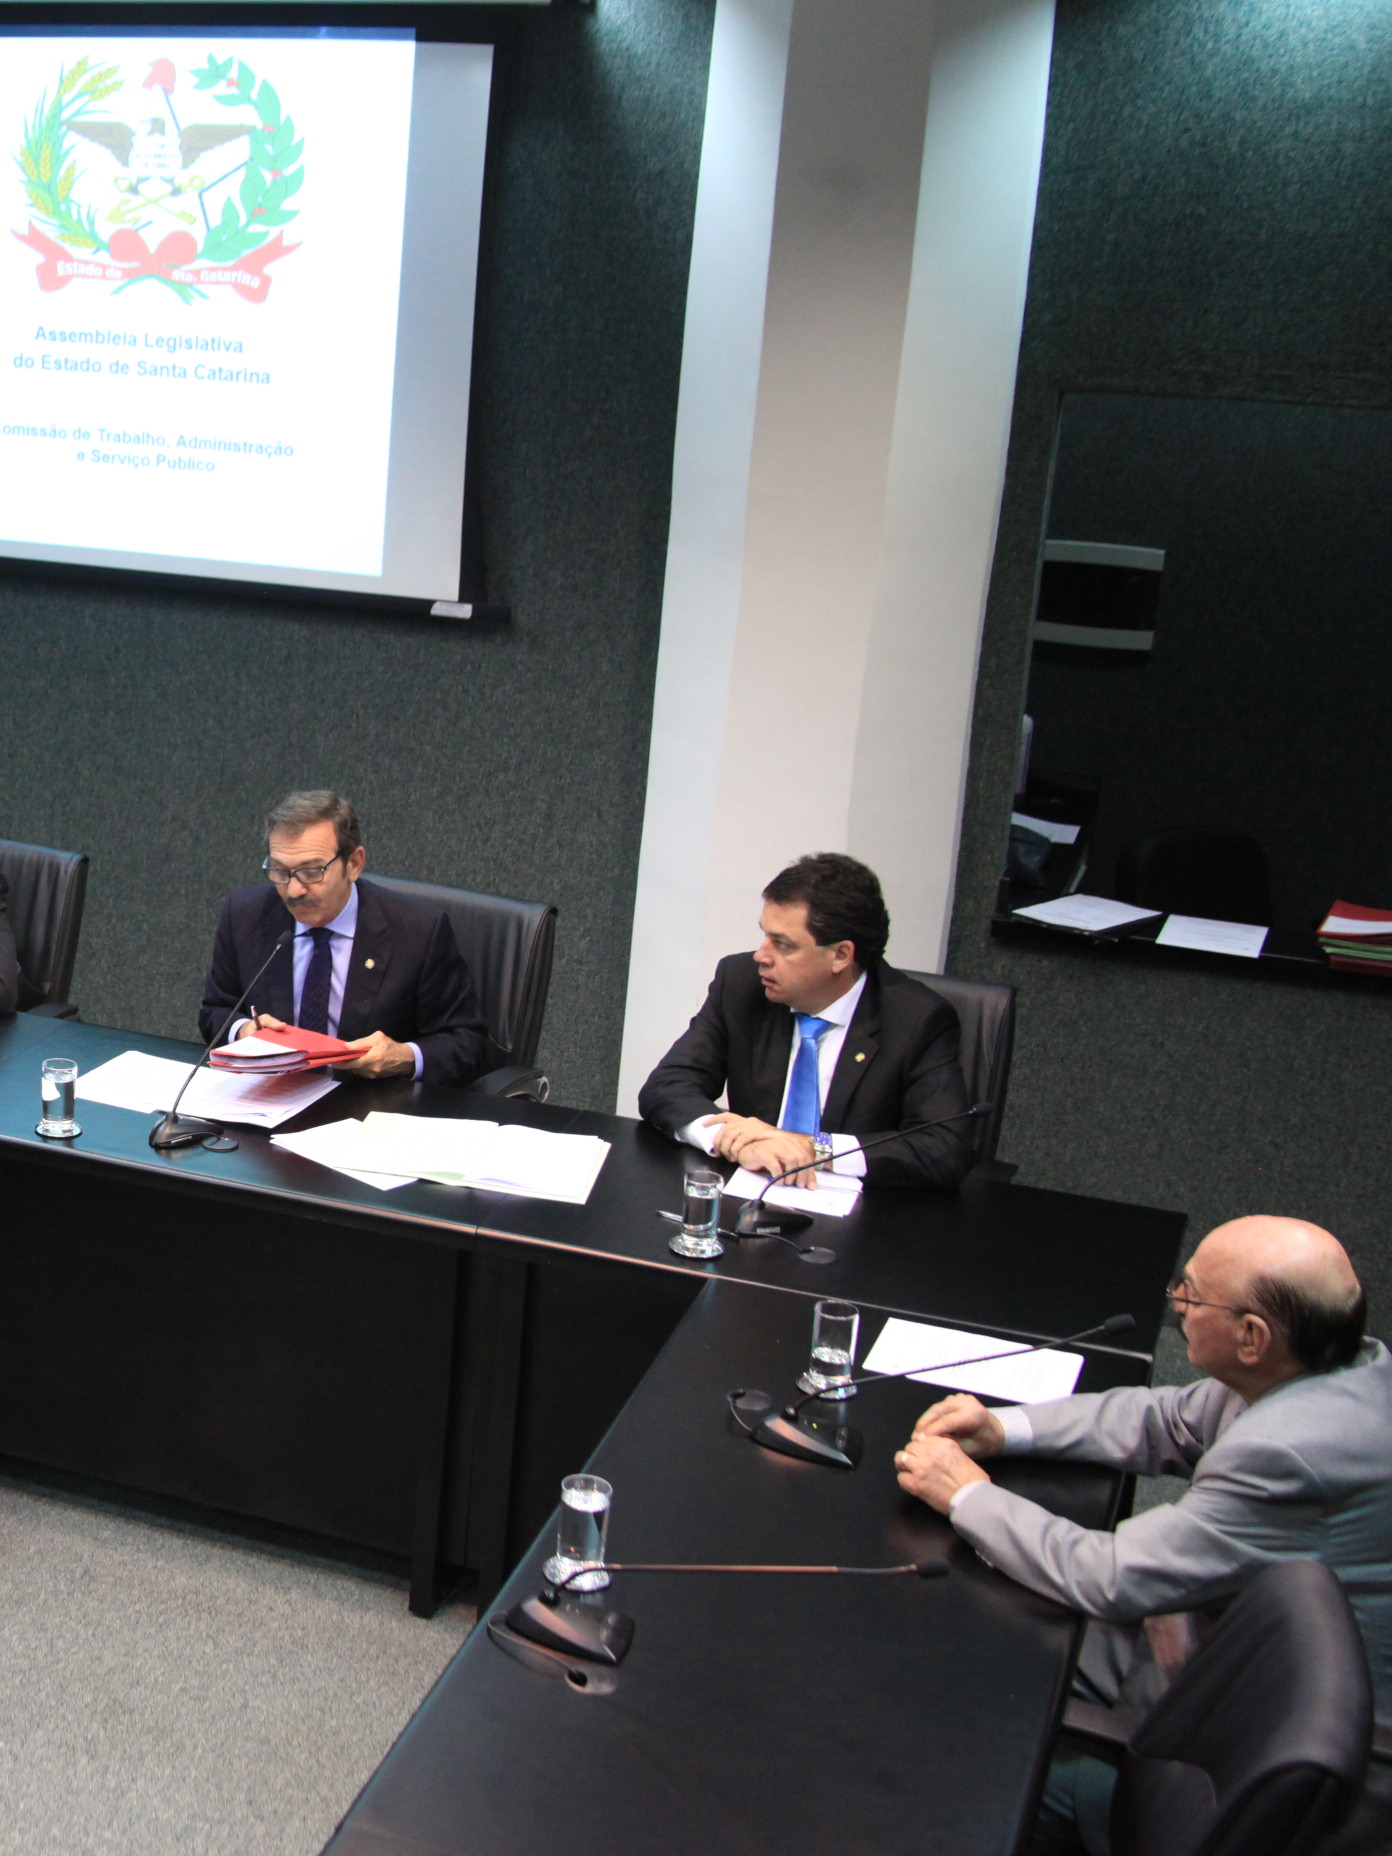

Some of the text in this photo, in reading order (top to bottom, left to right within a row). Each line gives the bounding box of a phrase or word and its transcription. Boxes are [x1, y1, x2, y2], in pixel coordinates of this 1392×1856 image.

[57, 260, 102, 277] Estado
[200, 270, 261, 288] Catarina
[35, 326, 244, 354] Assembleia Legislativa
[13, 353, 271, 385] do Estado de Santa Catarina
[72, 426, 91, 440] de
[97, 428, 171, 448] Trabalho,
[176, 434, 294, 458] Administração
[76, 449, 215, 472] e Serviço Público
